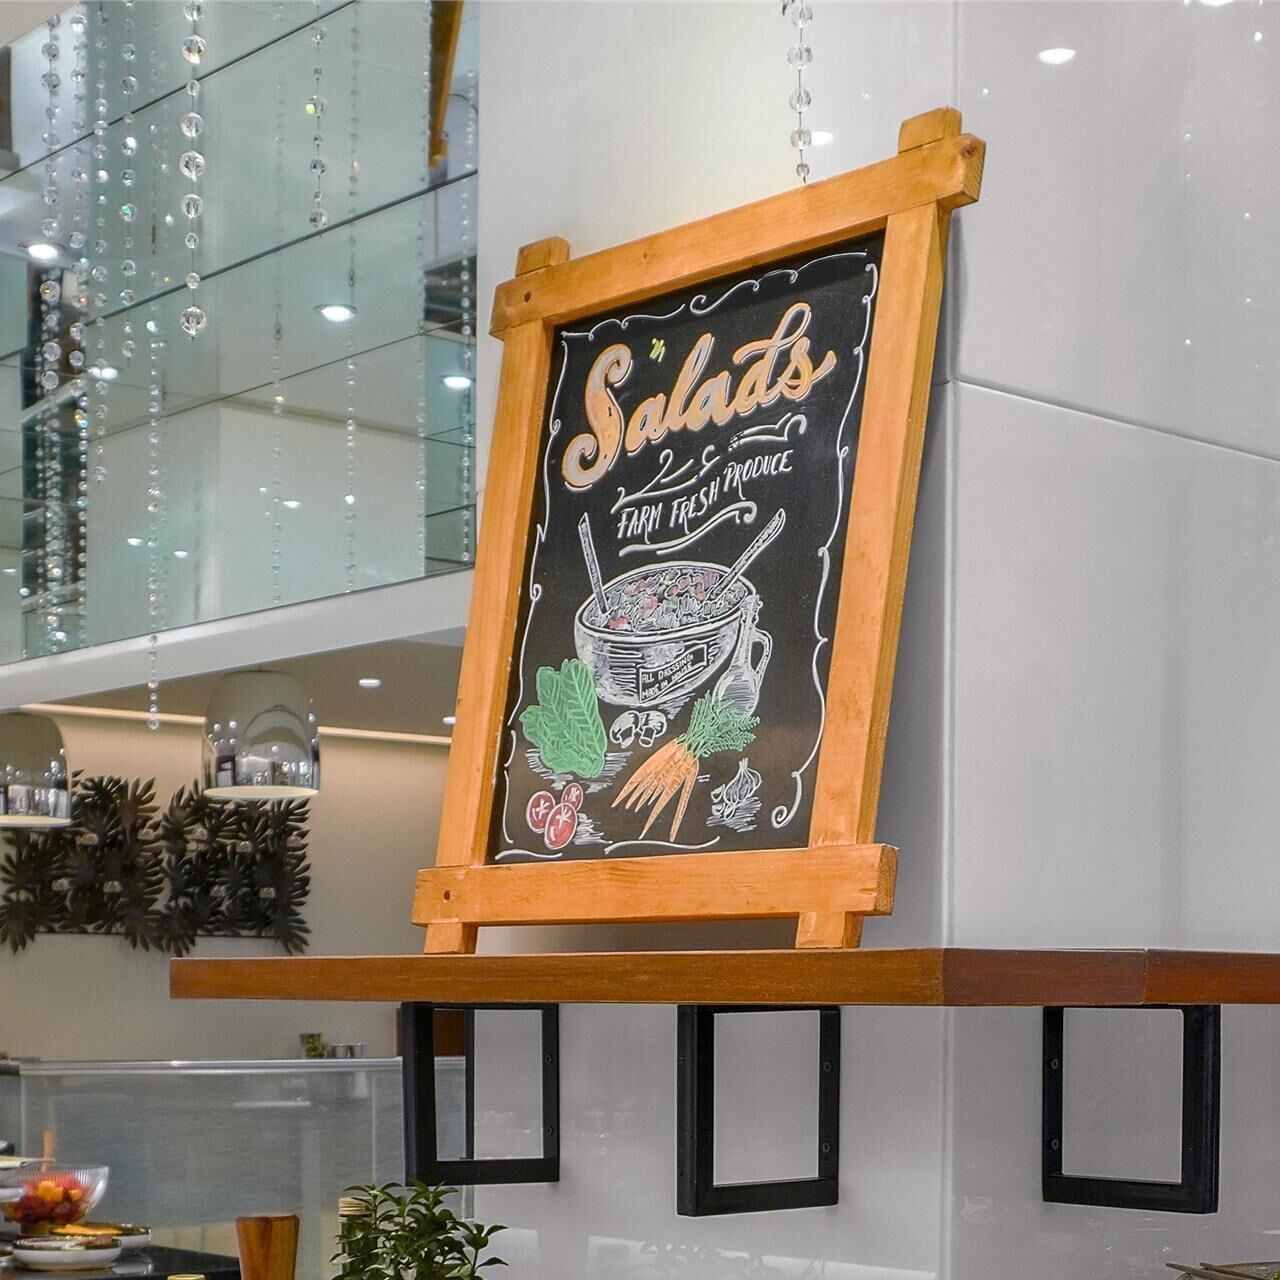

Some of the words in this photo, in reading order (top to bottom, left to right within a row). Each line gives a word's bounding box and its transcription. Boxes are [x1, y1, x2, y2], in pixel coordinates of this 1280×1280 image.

[562, 302, 837, 490] Salads
[617, 502, 663, 544] FARM
[670, 476, 720, 534] FRESH
[723, 449, 794, 500] PRODUCE
[641, 673, 655, 683] ALL
